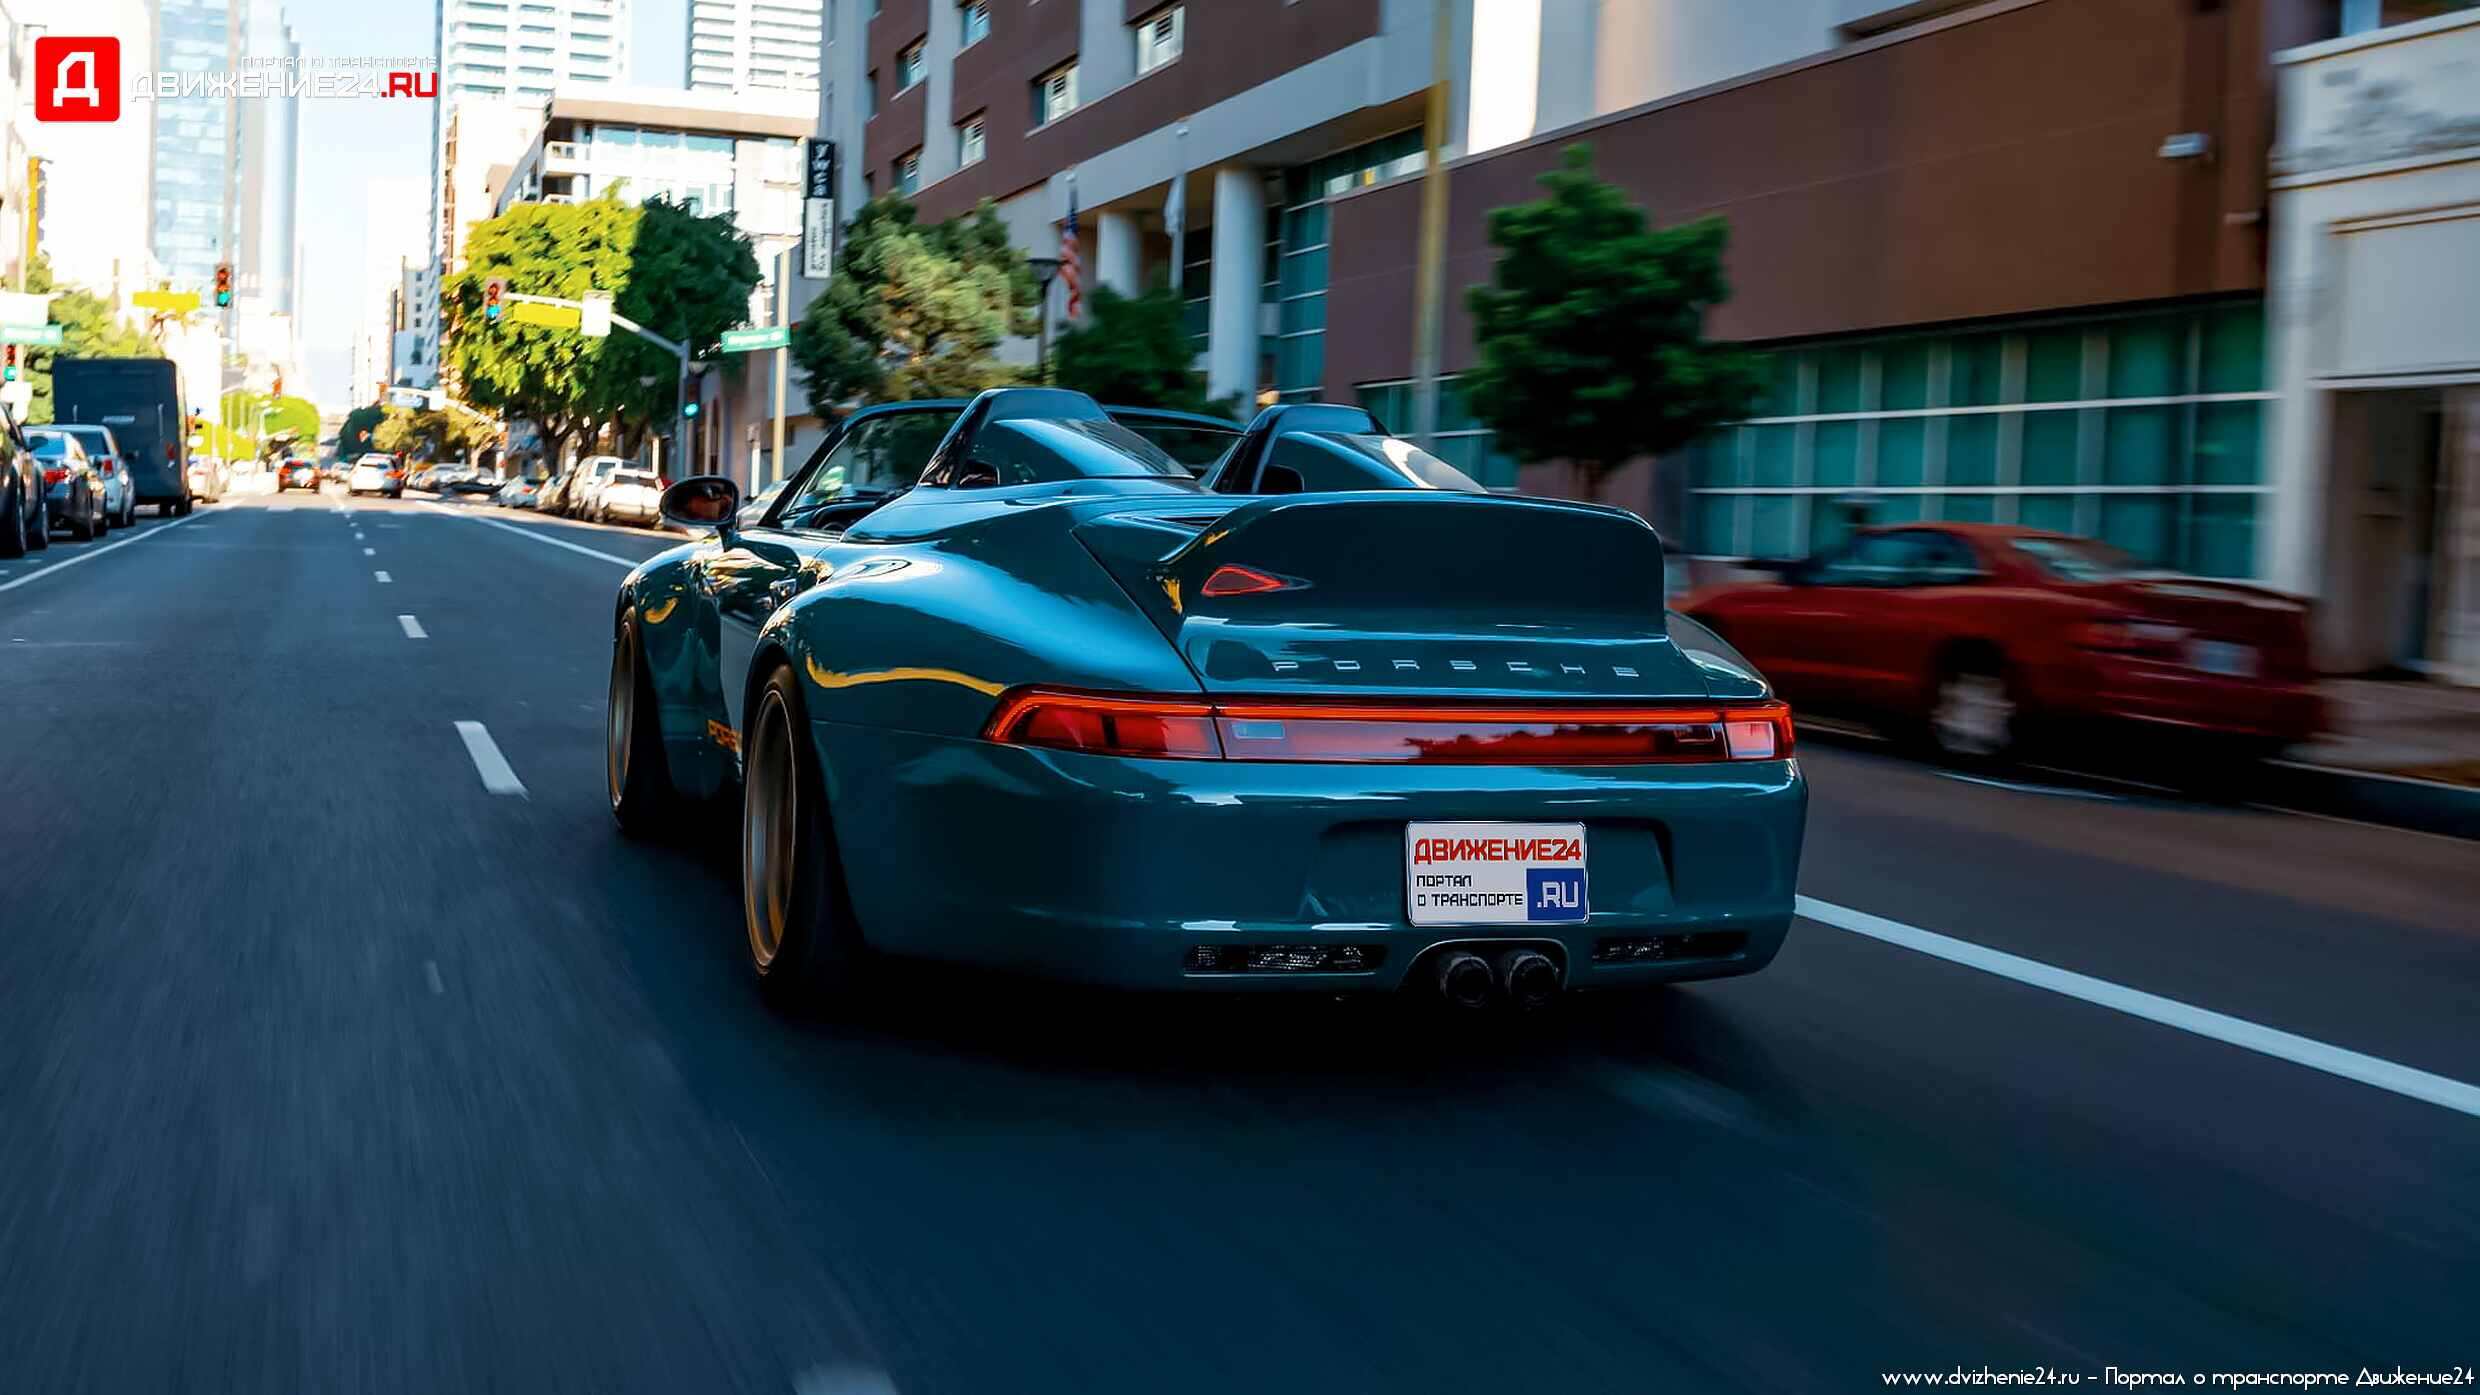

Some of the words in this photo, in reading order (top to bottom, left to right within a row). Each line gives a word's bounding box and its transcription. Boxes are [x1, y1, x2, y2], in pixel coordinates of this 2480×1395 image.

[1272, 659, 1640, 678] PORSCHE
[1414, 838, 1582, 864] ДВИЖЕНИЕ24
[1416, 875, 1472, 888] ПОРТАЛ
[1431, 893, 1524, 907] ТРАНСПОРТЕ
[1536, 881, 1579, 909] .RU
